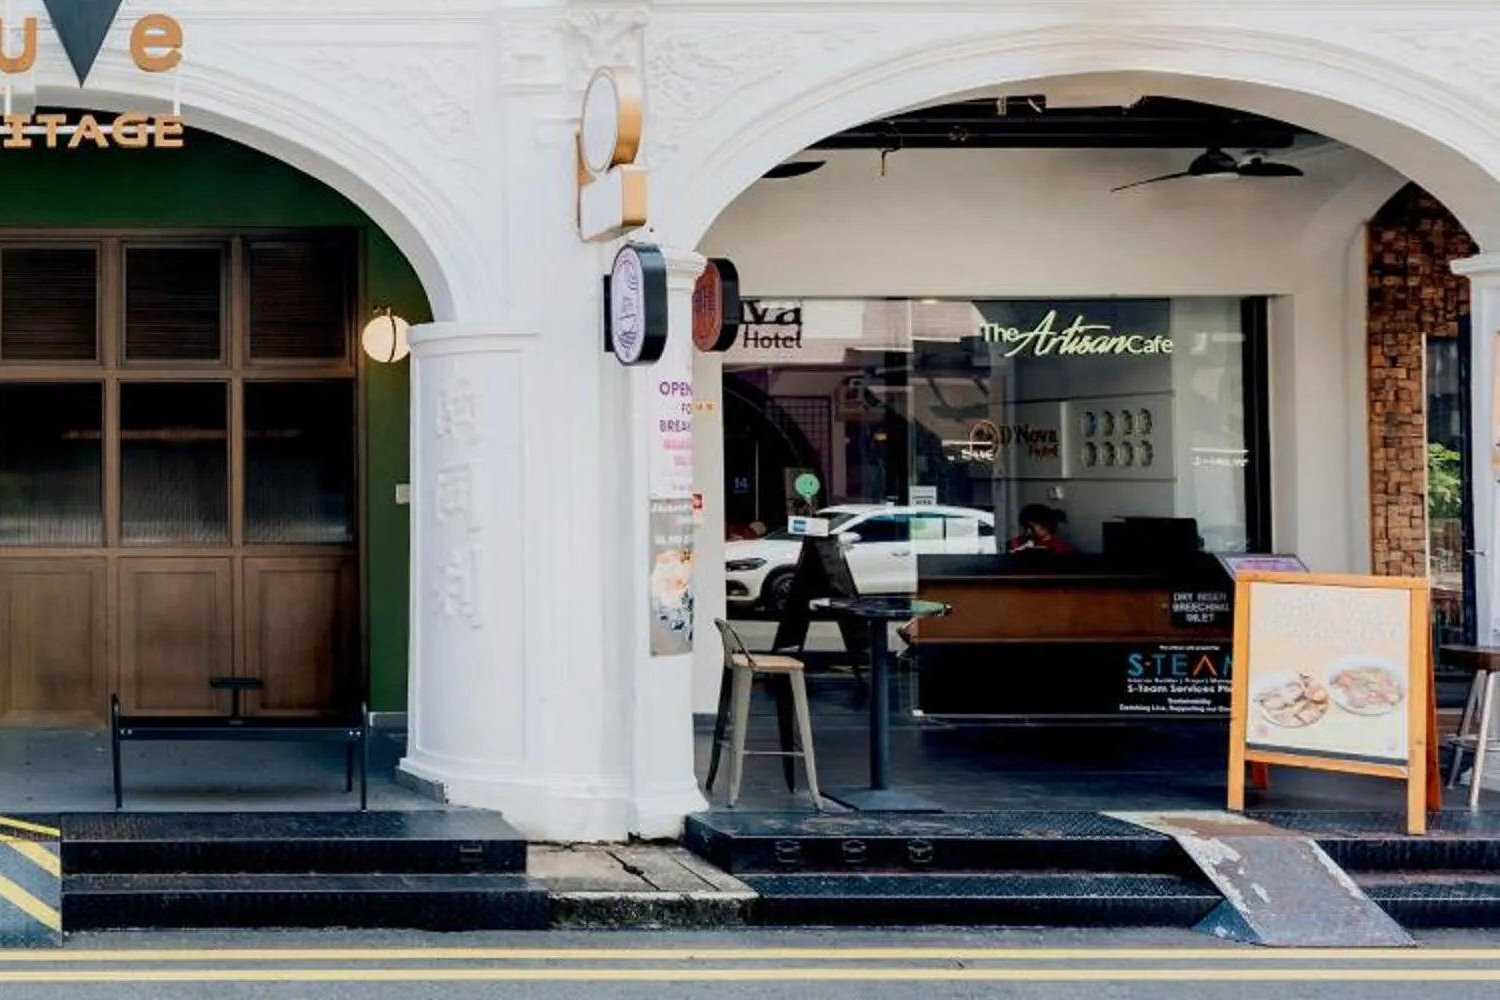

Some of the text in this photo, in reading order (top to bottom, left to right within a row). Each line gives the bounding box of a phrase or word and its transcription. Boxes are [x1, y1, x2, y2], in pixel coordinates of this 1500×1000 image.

[743, 323, 803, 349] Hotel
[980, 310, 1174, 358] The Artisan Cafe
